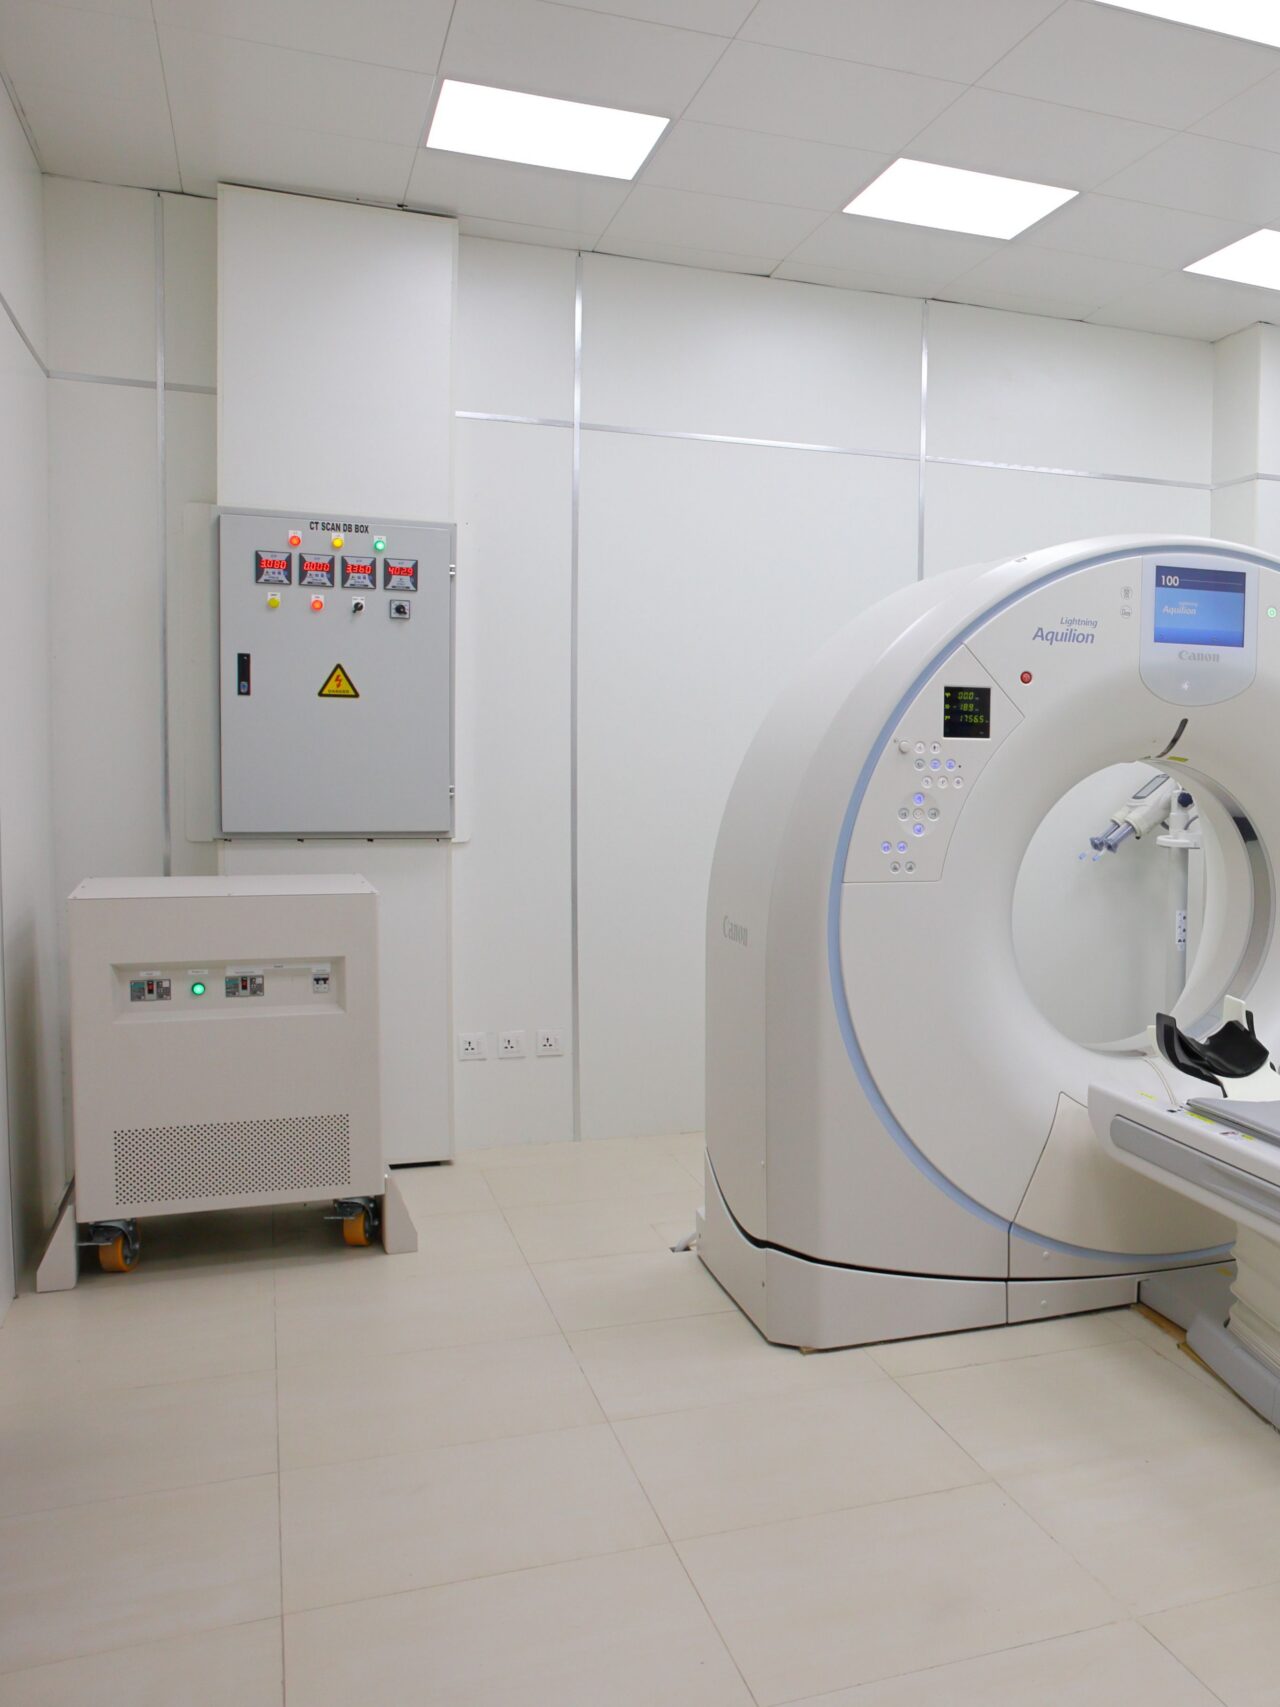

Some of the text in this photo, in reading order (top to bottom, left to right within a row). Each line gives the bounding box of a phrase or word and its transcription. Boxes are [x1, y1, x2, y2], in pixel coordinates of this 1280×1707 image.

[309, 521, 369, 534] CT SCAN DB BOX
[1161, 575, 1180, 587] 100
[1162, 605, 1197, 616] Aquilion
[1060, 616, 1098, 628] Lightning
[1032, 627, 1095, 646] Aquilion
[1178, 650, 1220, 663] Canon
[722, 914, 748, 947] Canon
